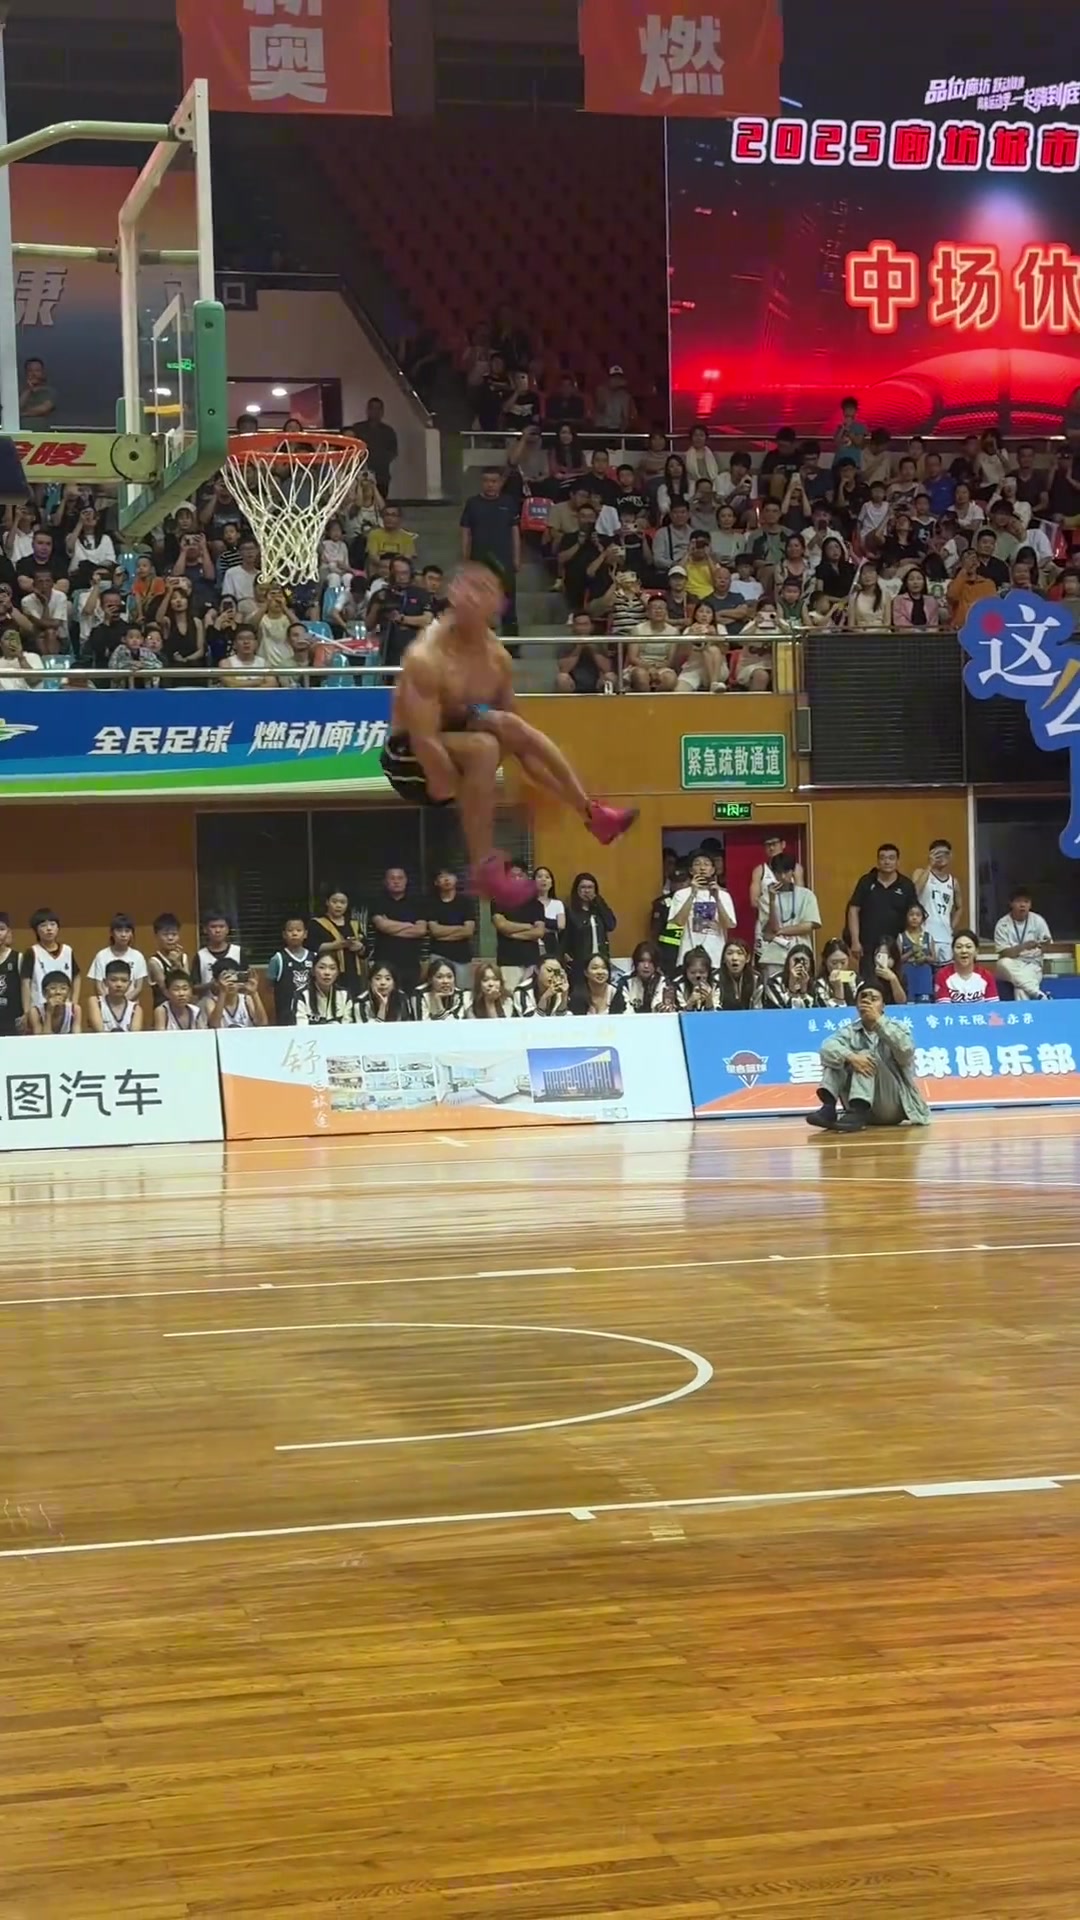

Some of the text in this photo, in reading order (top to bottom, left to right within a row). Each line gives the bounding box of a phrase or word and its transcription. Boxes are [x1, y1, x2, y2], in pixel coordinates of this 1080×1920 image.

[243, 0, 327, 103] 奥
[638, 14, 725, 96] 燃
[732, 117, 1080, 174] 2025廊坊城市
[848, 242, 1080, 332] 中场休
[87, 720, 390, 756] 全民足球 燃动廊坊
[687, 745, 781, 776] 紧急疏散通道
[0, 1069, 163, 1121] 图汽车
